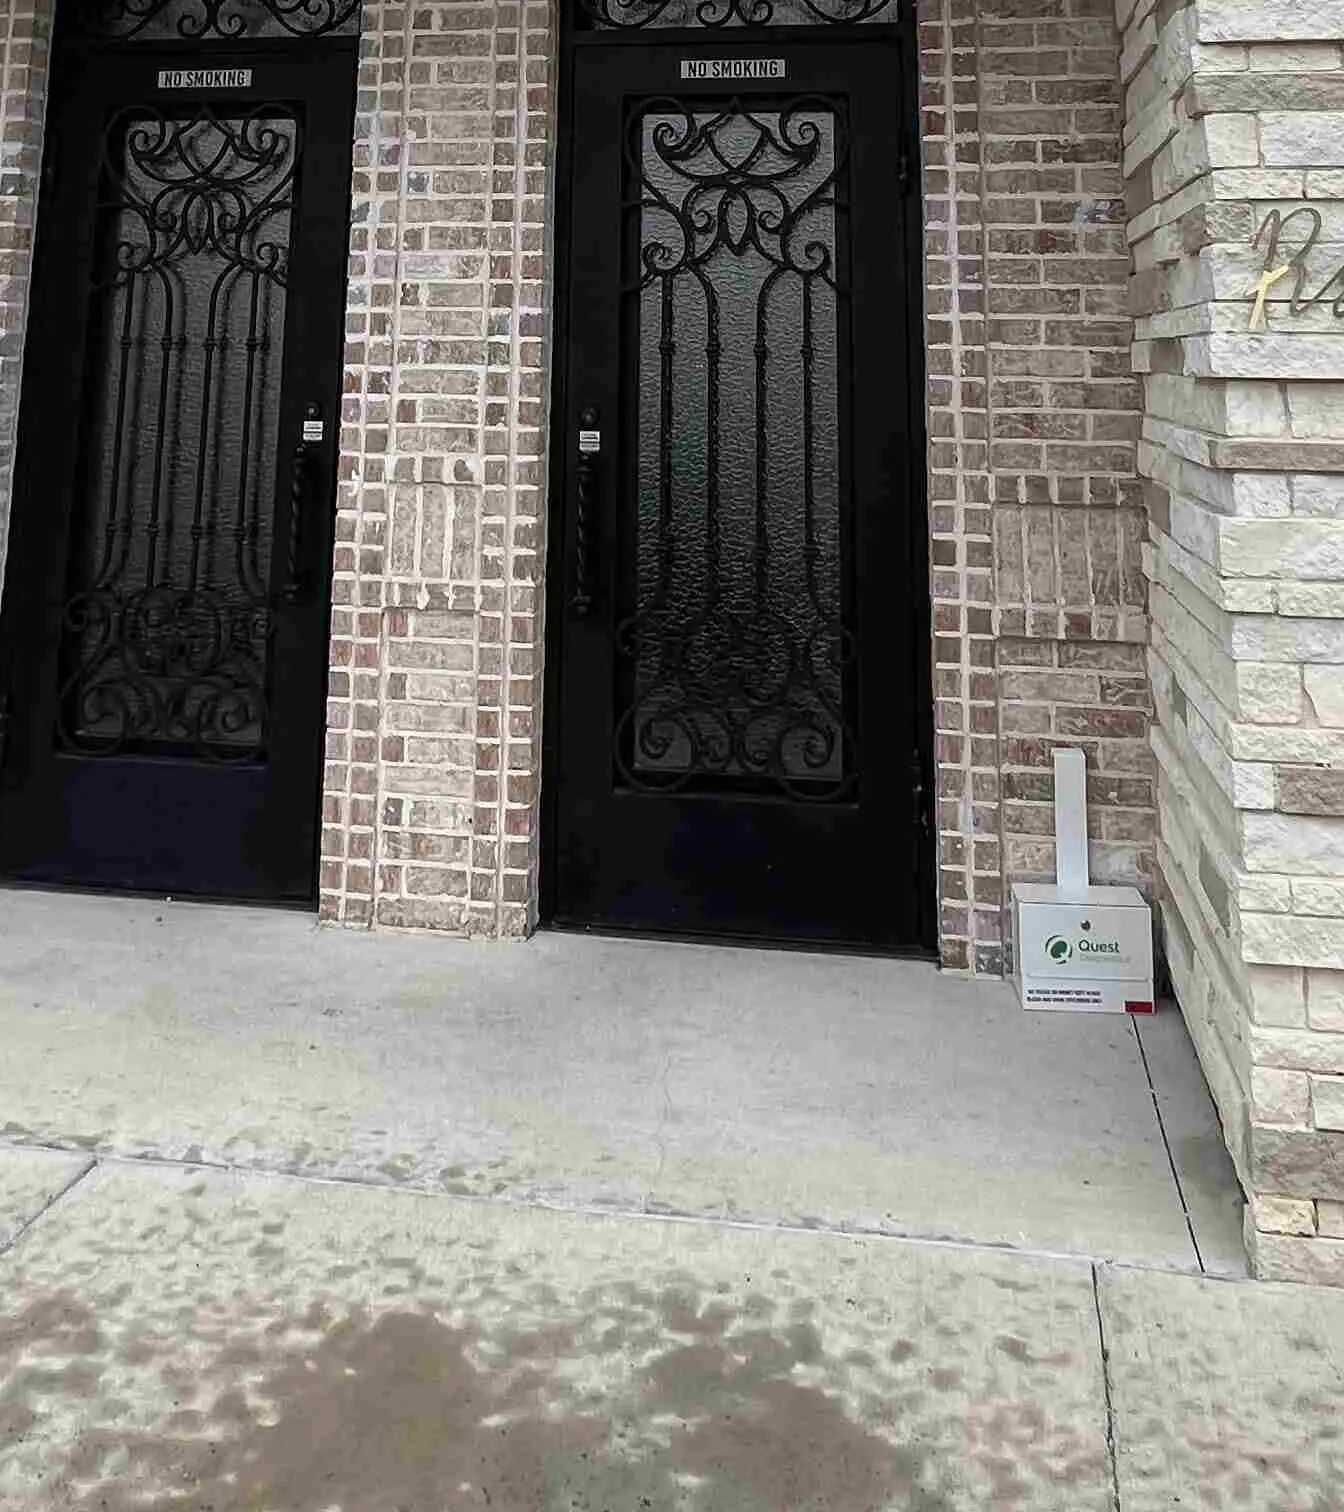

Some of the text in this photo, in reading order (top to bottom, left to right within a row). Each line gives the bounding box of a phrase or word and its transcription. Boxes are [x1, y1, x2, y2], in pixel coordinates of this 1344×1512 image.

[687, 60, 778, 77] NO SMOKING
[164, 70, 245, 87] NO SMOKING
[1078, 938, 1120, 954] Quest
